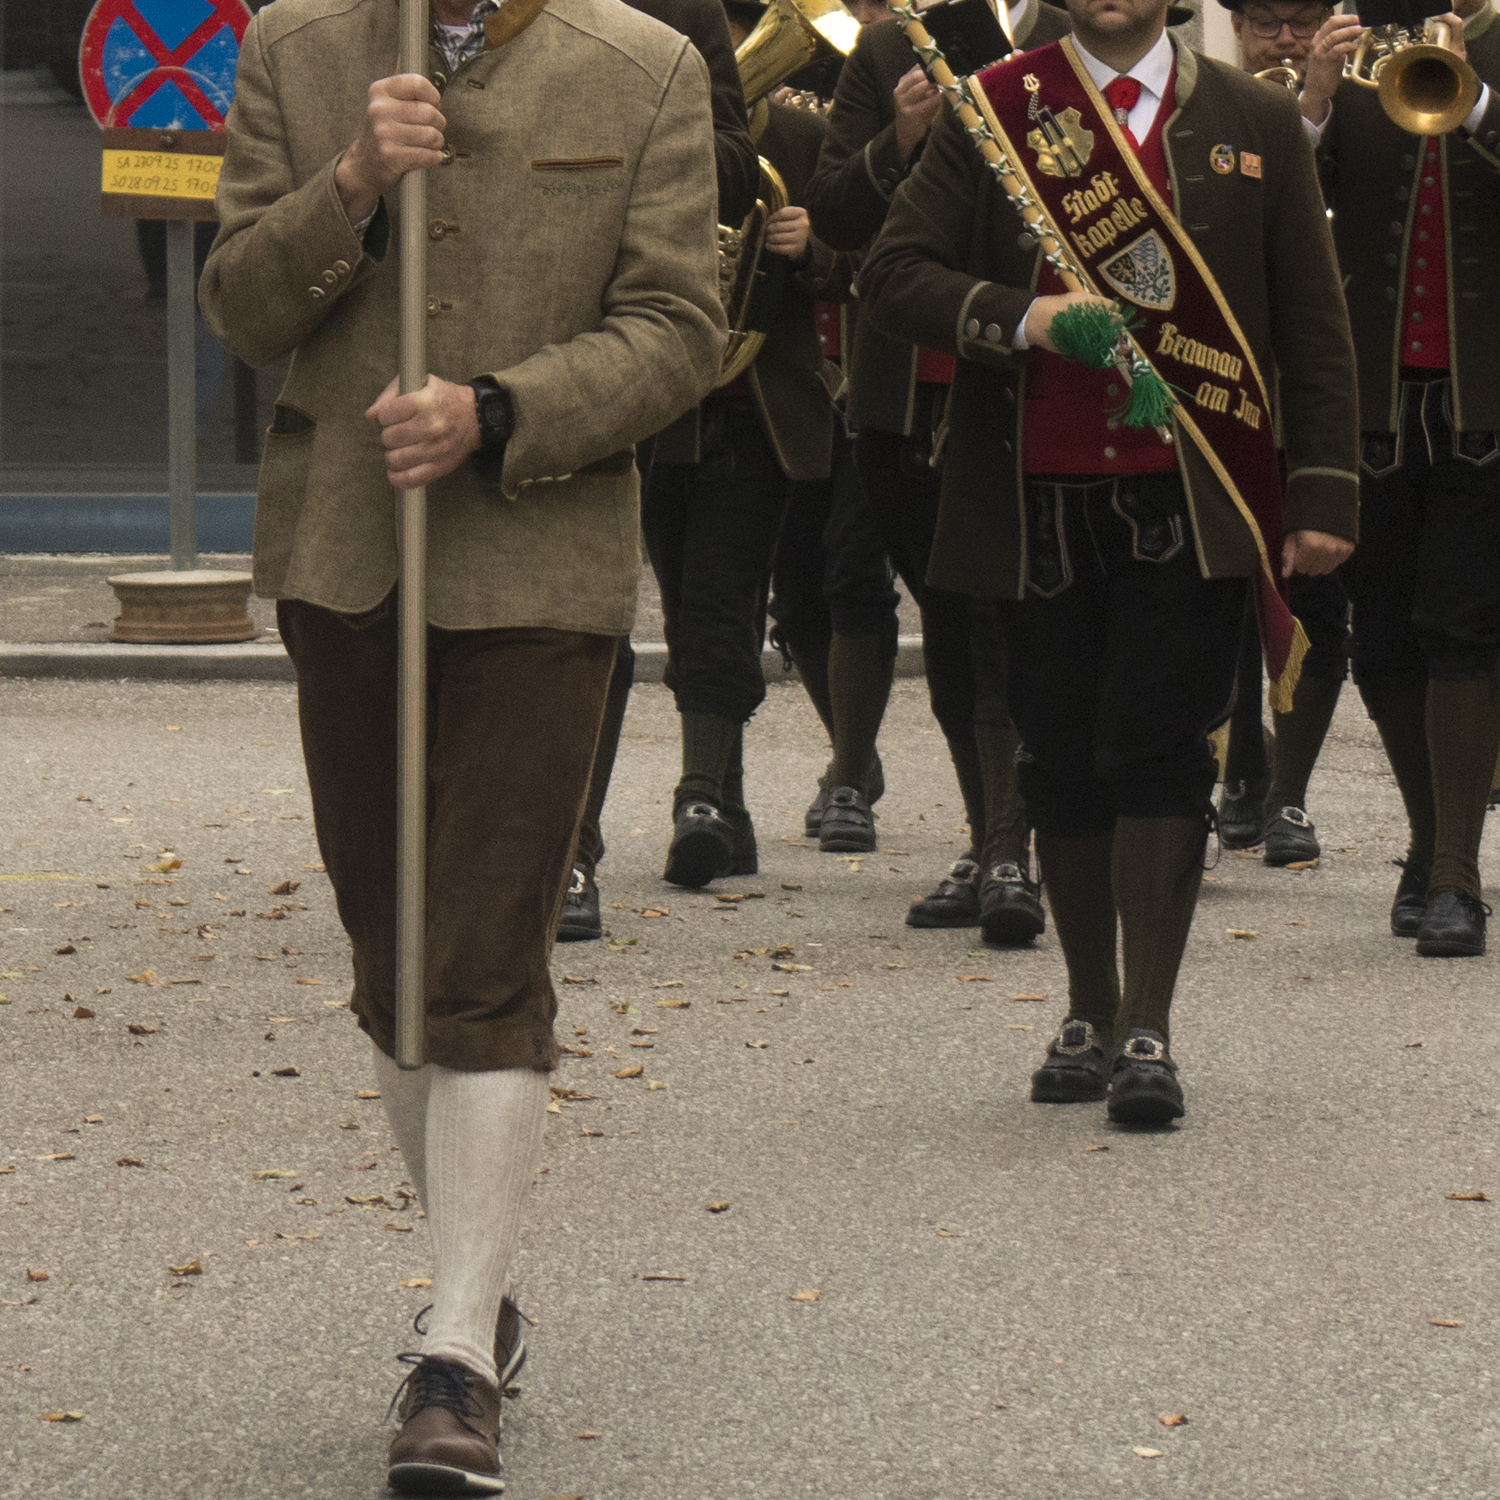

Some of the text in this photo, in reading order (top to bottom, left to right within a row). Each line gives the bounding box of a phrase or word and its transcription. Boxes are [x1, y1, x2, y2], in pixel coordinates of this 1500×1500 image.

[116, 156, 131, 169] SA
[1061, 171, 1119, 224] Stadt-
[1070, 197, 1148, 258] kapelle
[1155, 322, 1242, 382] Braunau
[1195, 381, 1229, 413] am
